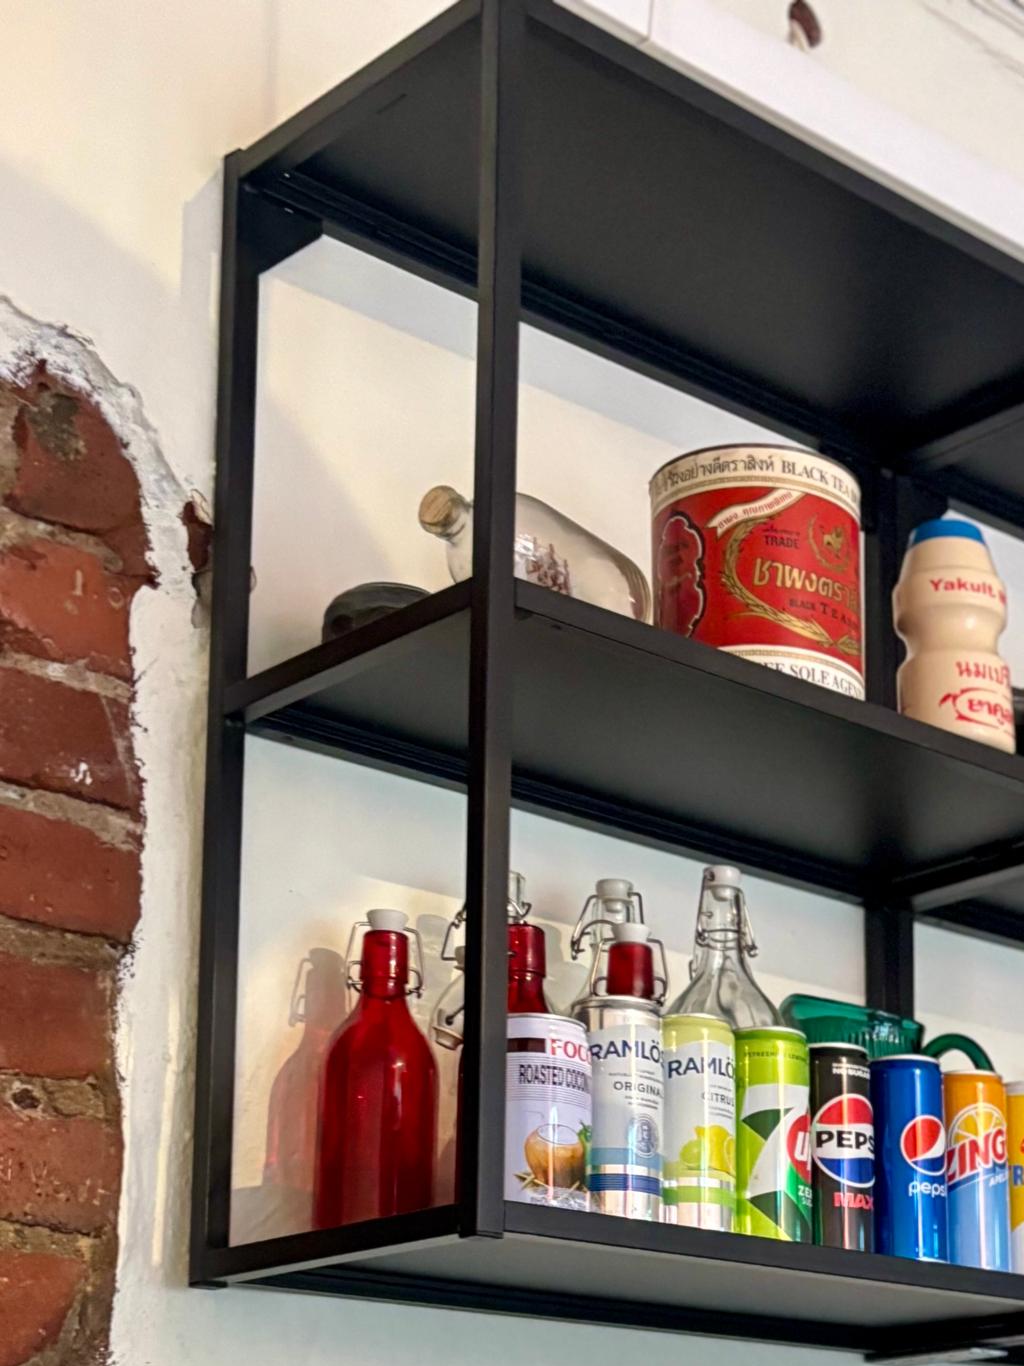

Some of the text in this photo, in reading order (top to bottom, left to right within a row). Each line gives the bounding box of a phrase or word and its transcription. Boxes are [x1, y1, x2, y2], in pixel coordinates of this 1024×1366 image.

[781, 459, 829, 486] BLACK
[764, 534, 800, 549] TRADE
[930, 578, 996, 598] Yakult
[789, 663, 830, 687] SOLE
[519, 1064, 563, 1087] ROASTED
